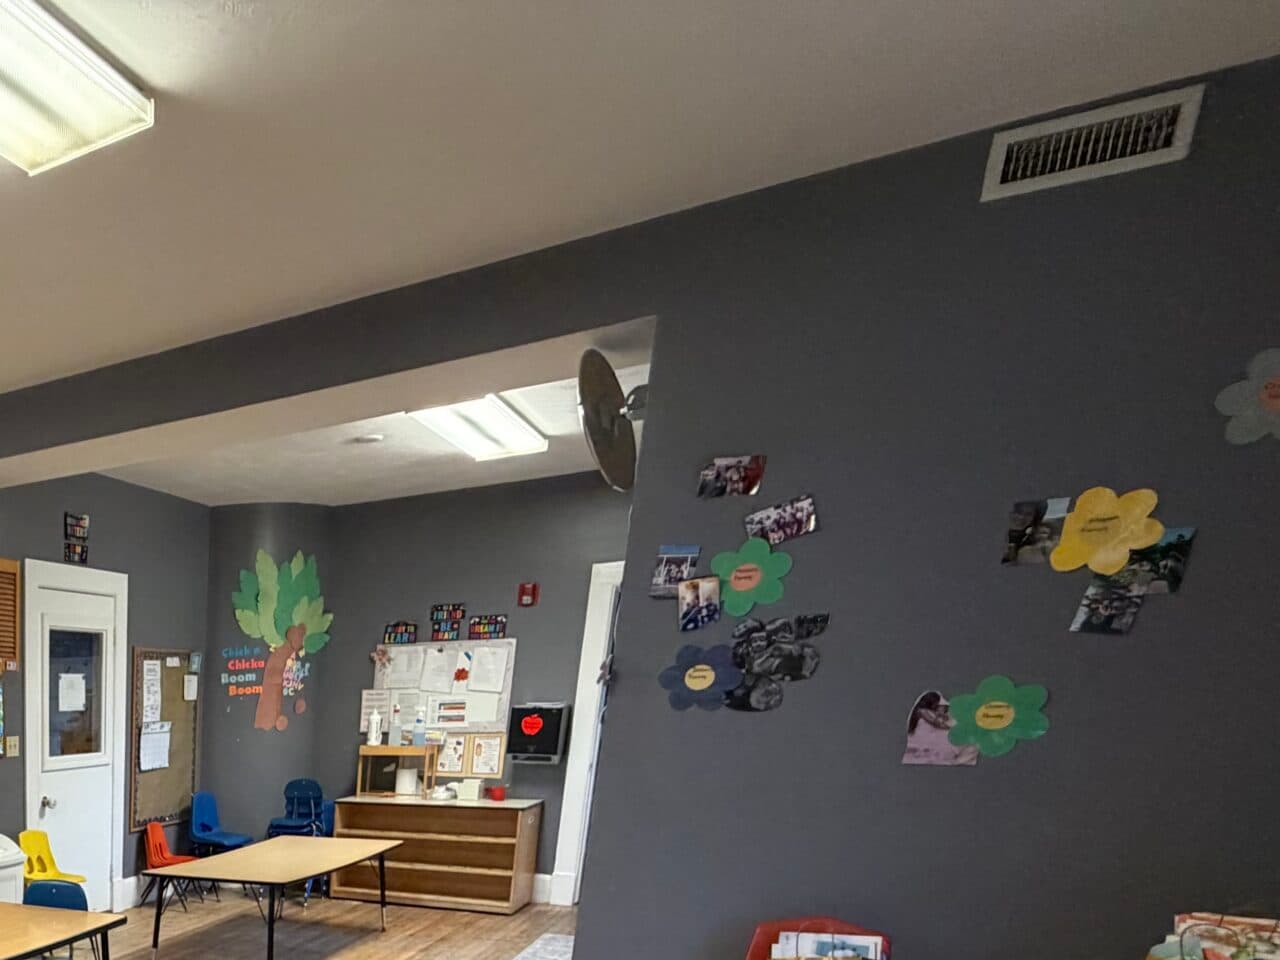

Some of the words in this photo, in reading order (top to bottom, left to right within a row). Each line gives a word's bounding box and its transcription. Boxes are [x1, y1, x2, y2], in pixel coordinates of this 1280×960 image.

[384, 633, 416, 643] LEARN
[227, 659, 266, 671] Chicka
[221, 673, 257, 685] Boom
[228, 685, 263, 697] Boom
